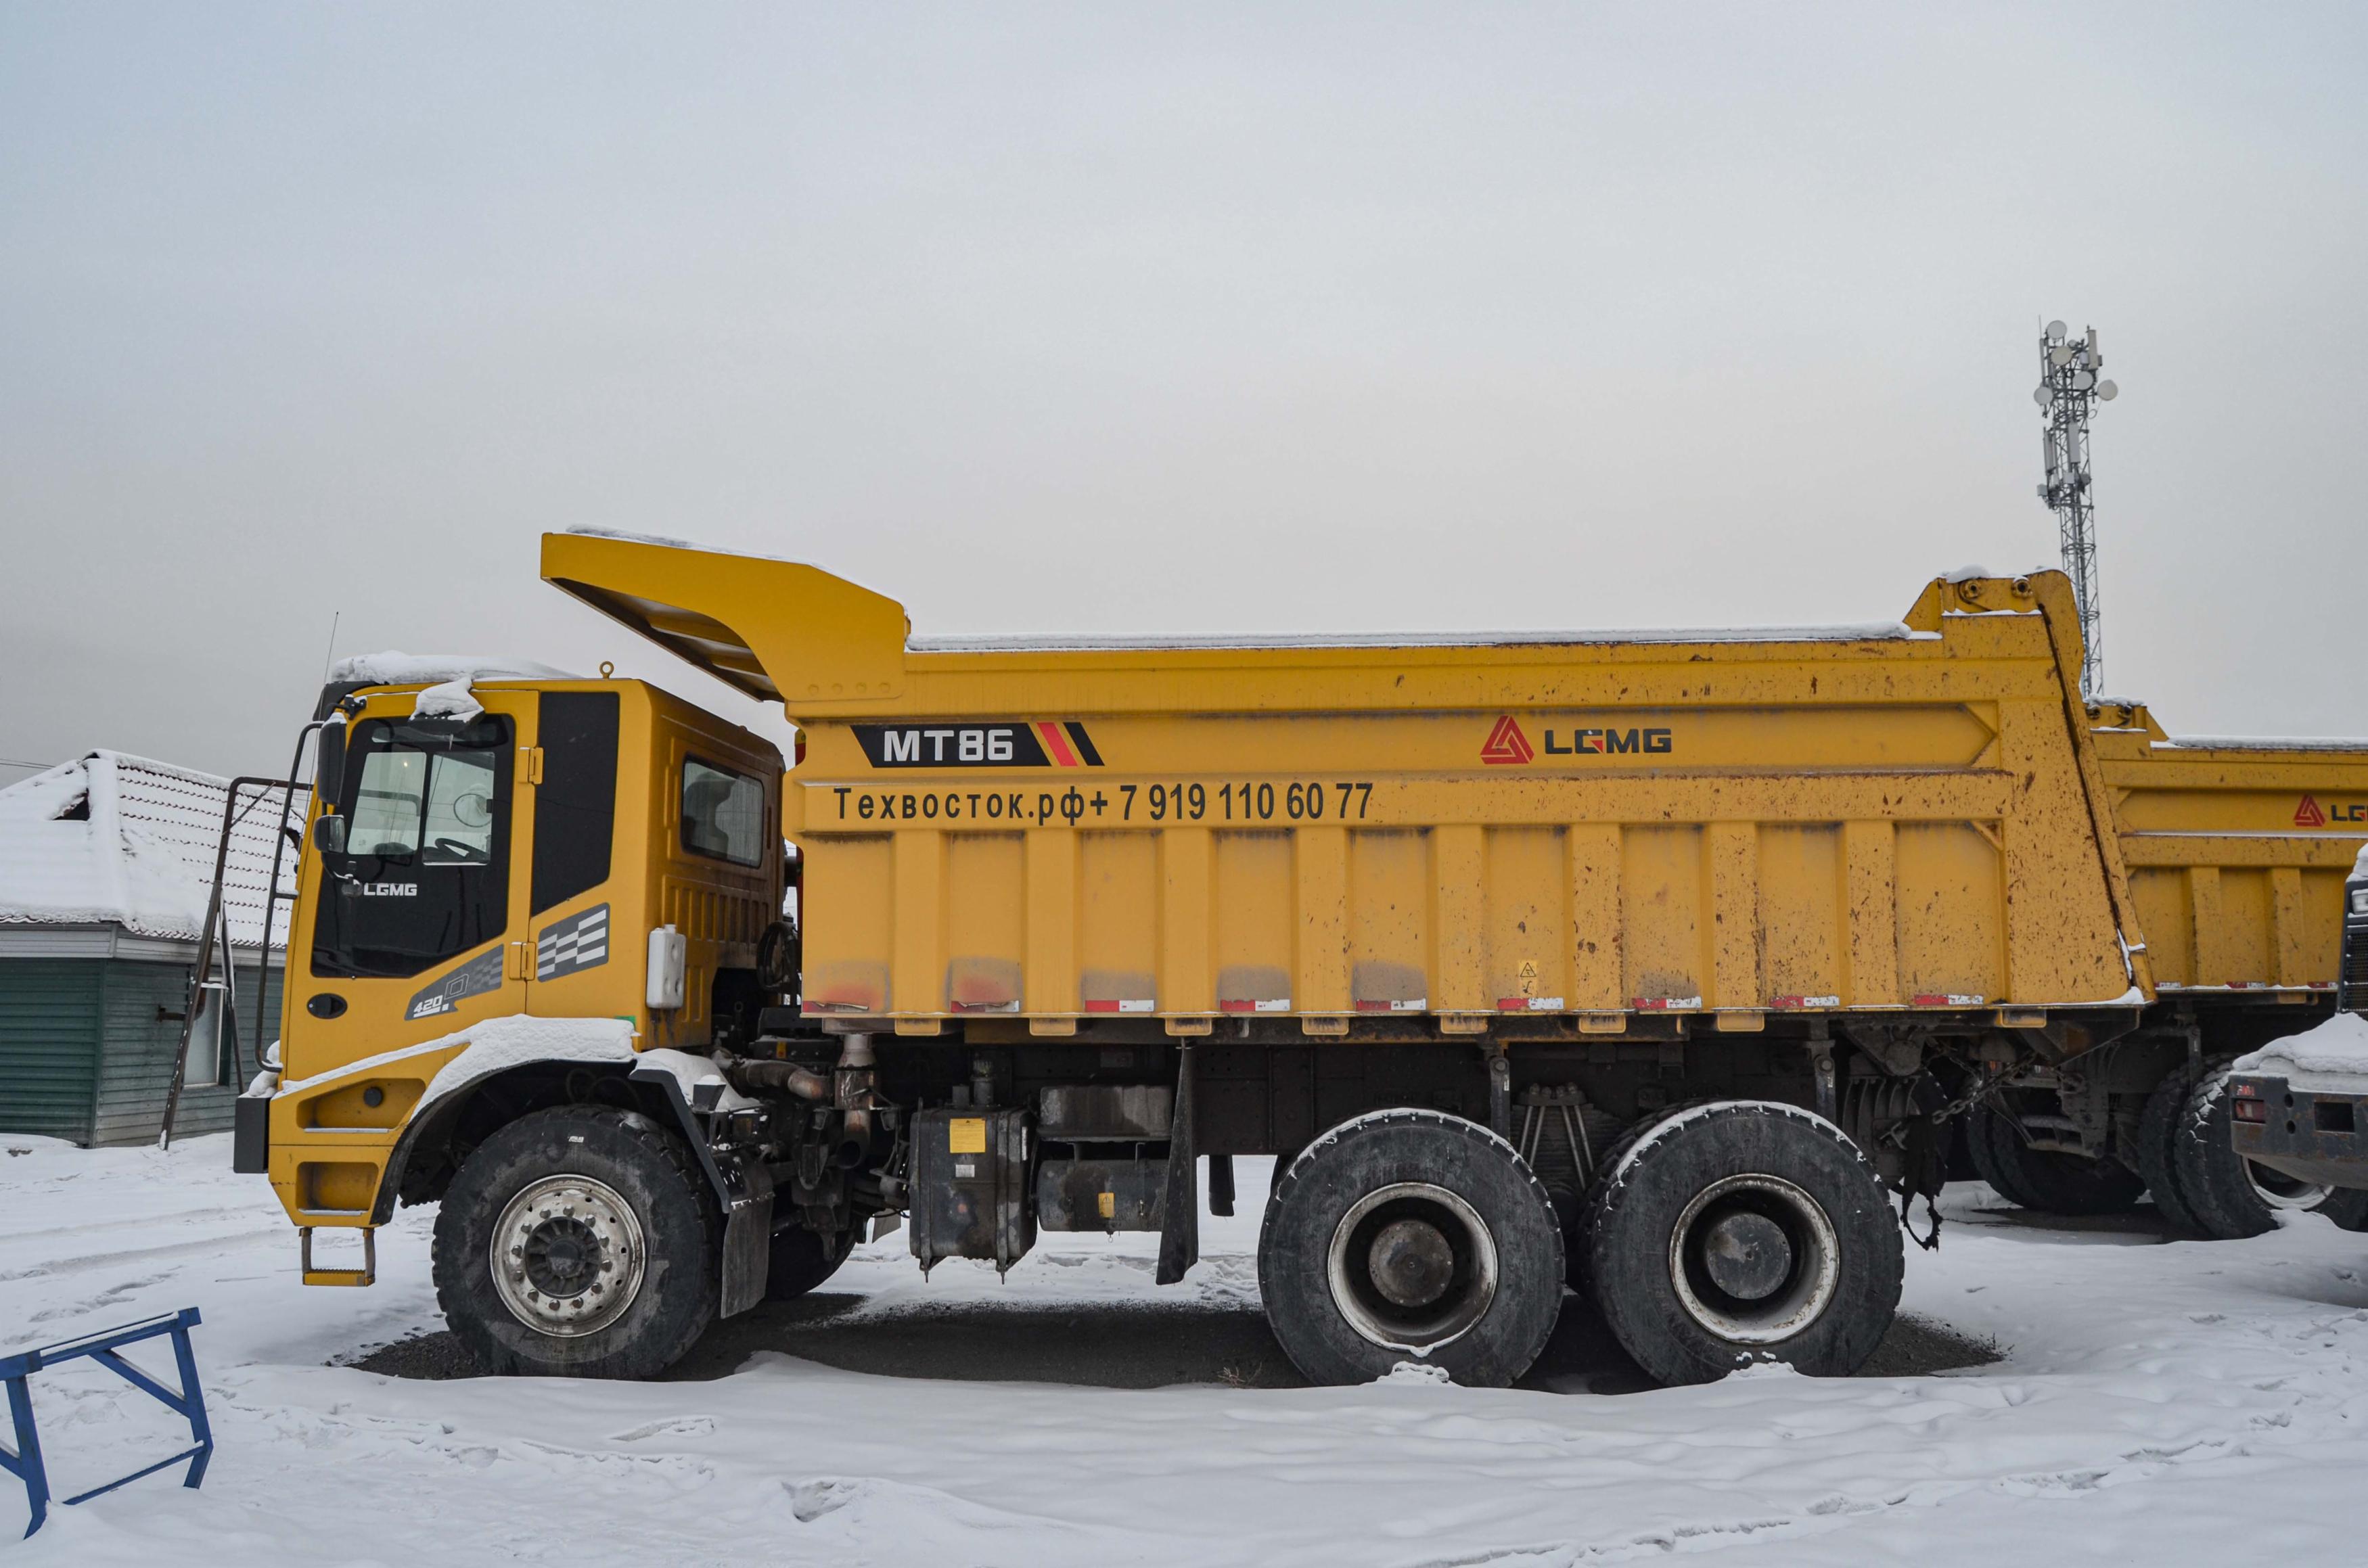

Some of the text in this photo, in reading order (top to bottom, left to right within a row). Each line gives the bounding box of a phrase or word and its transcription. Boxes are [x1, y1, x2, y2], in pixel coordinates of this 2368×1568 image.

[884, 729, 1014, 762] MT86
[1545, 729, 1672, 754] LGMG
[1149, 783, 1206, 820] 919
[1219, 783, 1274, 820] 110
[1288, 783, 1323, 819] 60
[1336, 783, 1373, 819] 77
[2331, 805, 2368, 822] LG
[364, 883, 417, 896] LGMG
[413, 994, 443, 1013] 420
